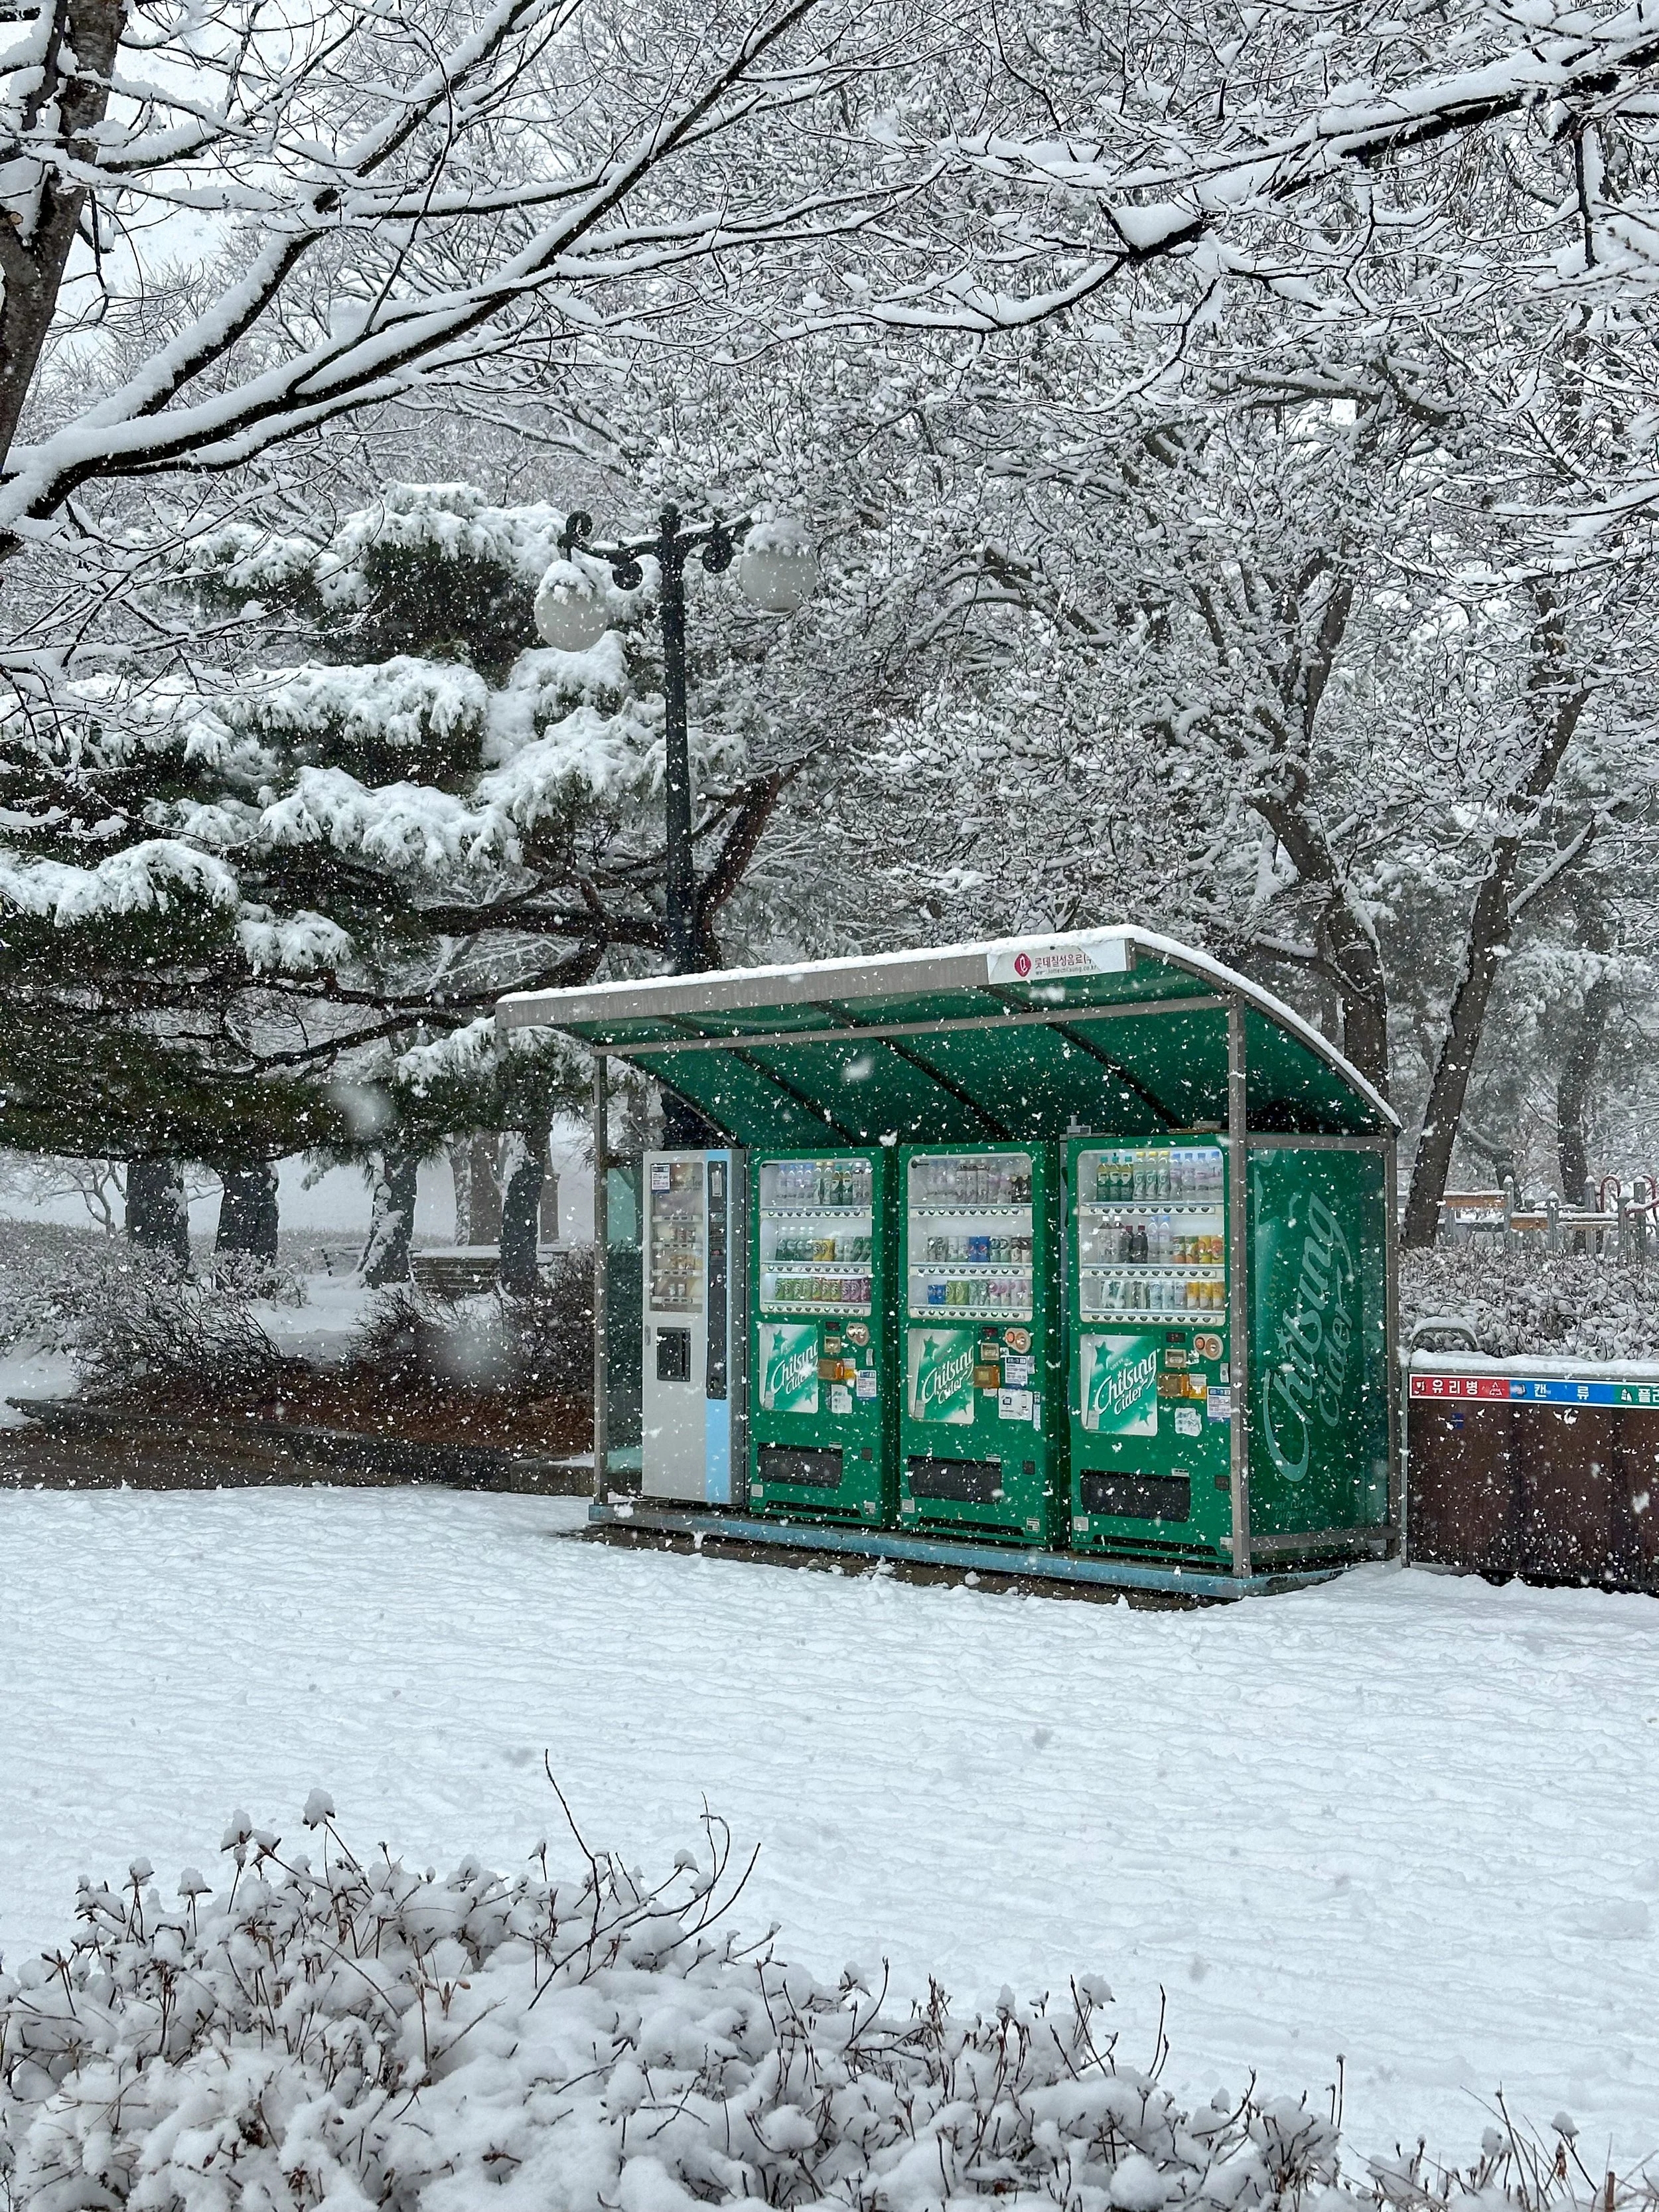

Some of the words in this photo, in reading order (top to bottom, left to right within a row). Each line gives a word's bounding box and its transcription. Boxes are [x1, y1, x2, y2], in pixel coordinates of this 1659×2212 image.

[1094, 1350, 1157, 1414] Chilsung
[1263, 1193, 1354, 1481] Chilsung
[1319, 1264, 1352, 1427] Cider
[1114, 1378, 1148, 1415] Cider
